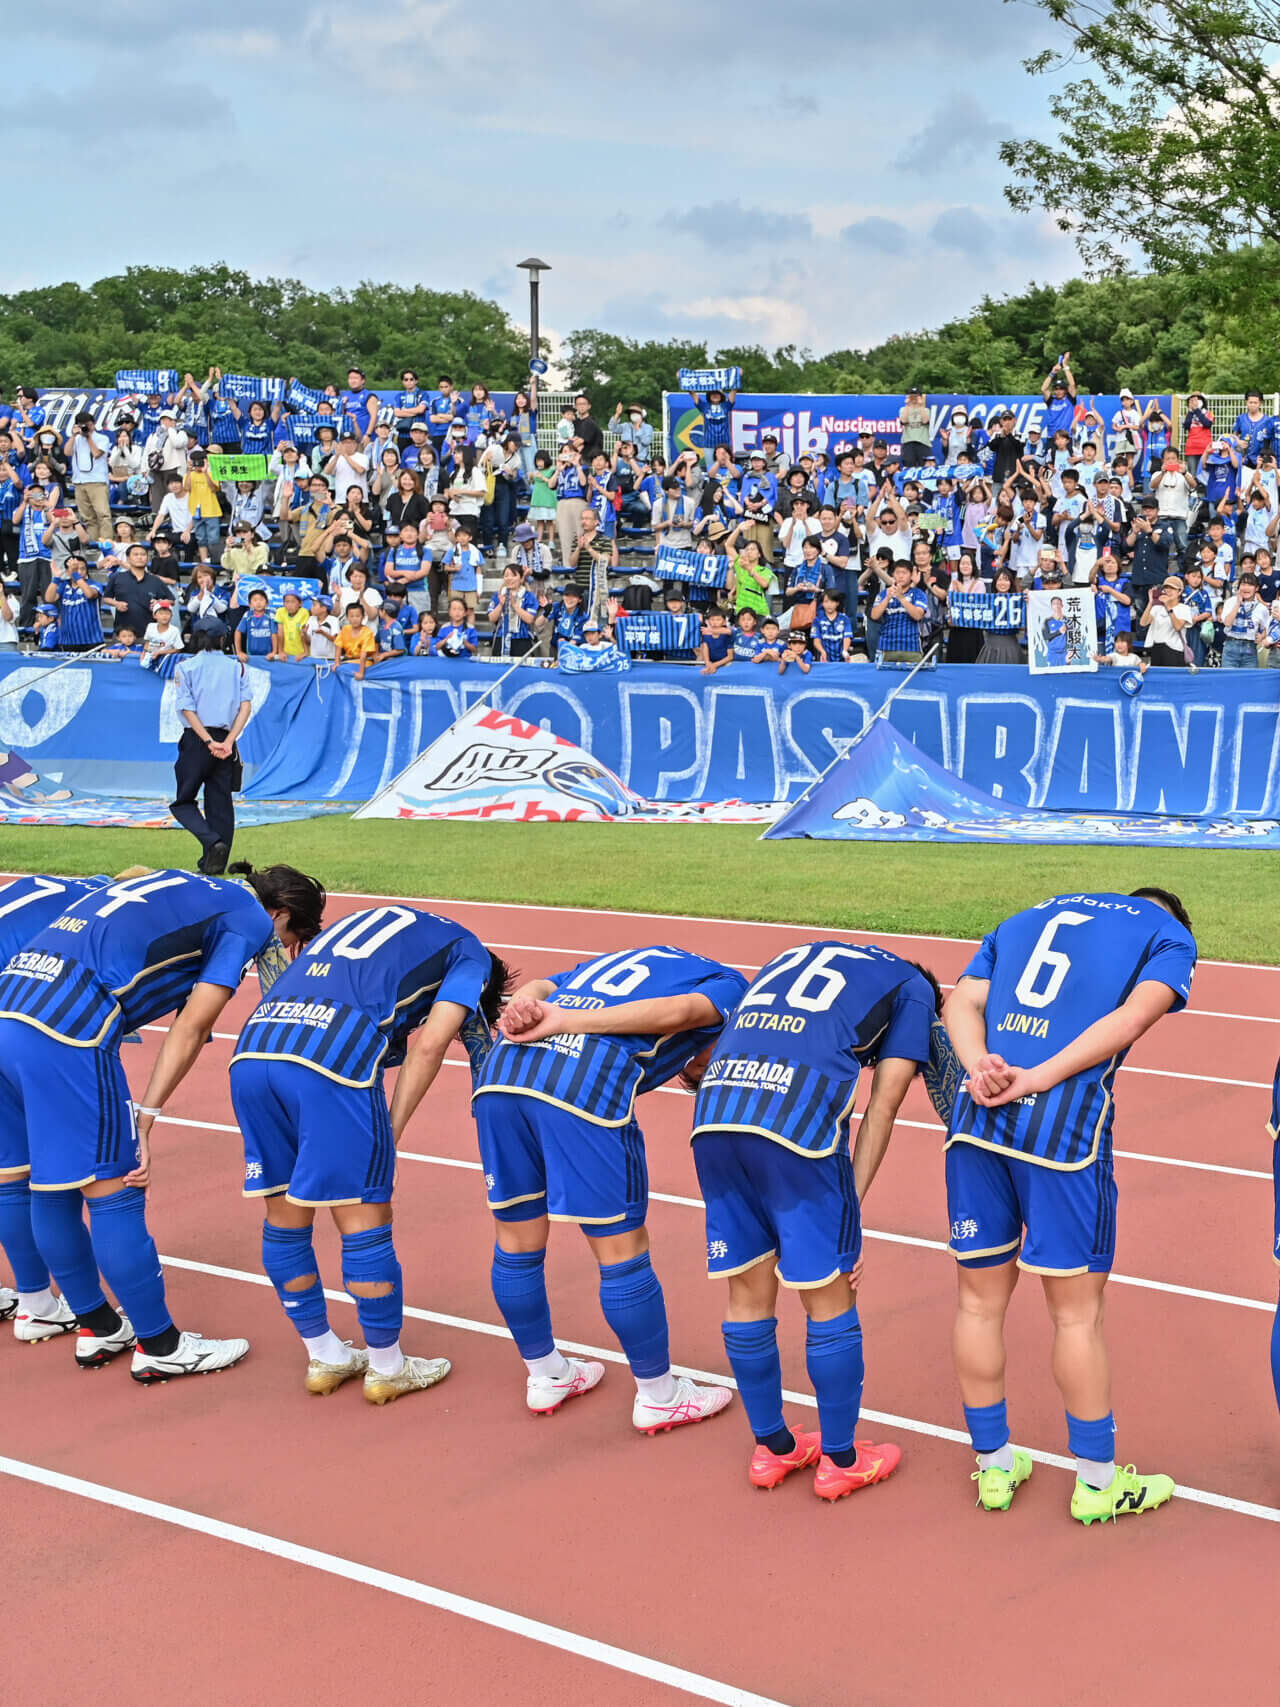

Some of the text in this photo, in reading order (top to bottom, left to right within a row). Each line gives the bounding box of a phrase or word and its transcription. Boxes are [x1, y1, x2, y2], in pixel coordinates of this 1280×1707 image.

[261, 377, 281, 400] 14
[821, 416, 903, 433] Nasciment
[701, 556, 718, 584] 9
[994, 595, 1021, 627] 26
[672, 616, 688, 648] 7
[1066, 597, 1083, 660] 荒木駿太
[305, 905, 417, 960] 10
[305, 962, 333, 977] NA
[565, 948, 686, 997] 16
[1015, 911, 1096, 1009] 6
[737, 944, 877, 1013] 26
[270, 1001, 338, 1023] TERADA
[552, 994, 606, 1011] ZENTO
[734, 1011, 807, 1035] KOTARO
[996, 1012, 1051, 1039] JUNYA
[722, 1059, 795, 1086] TERADA
